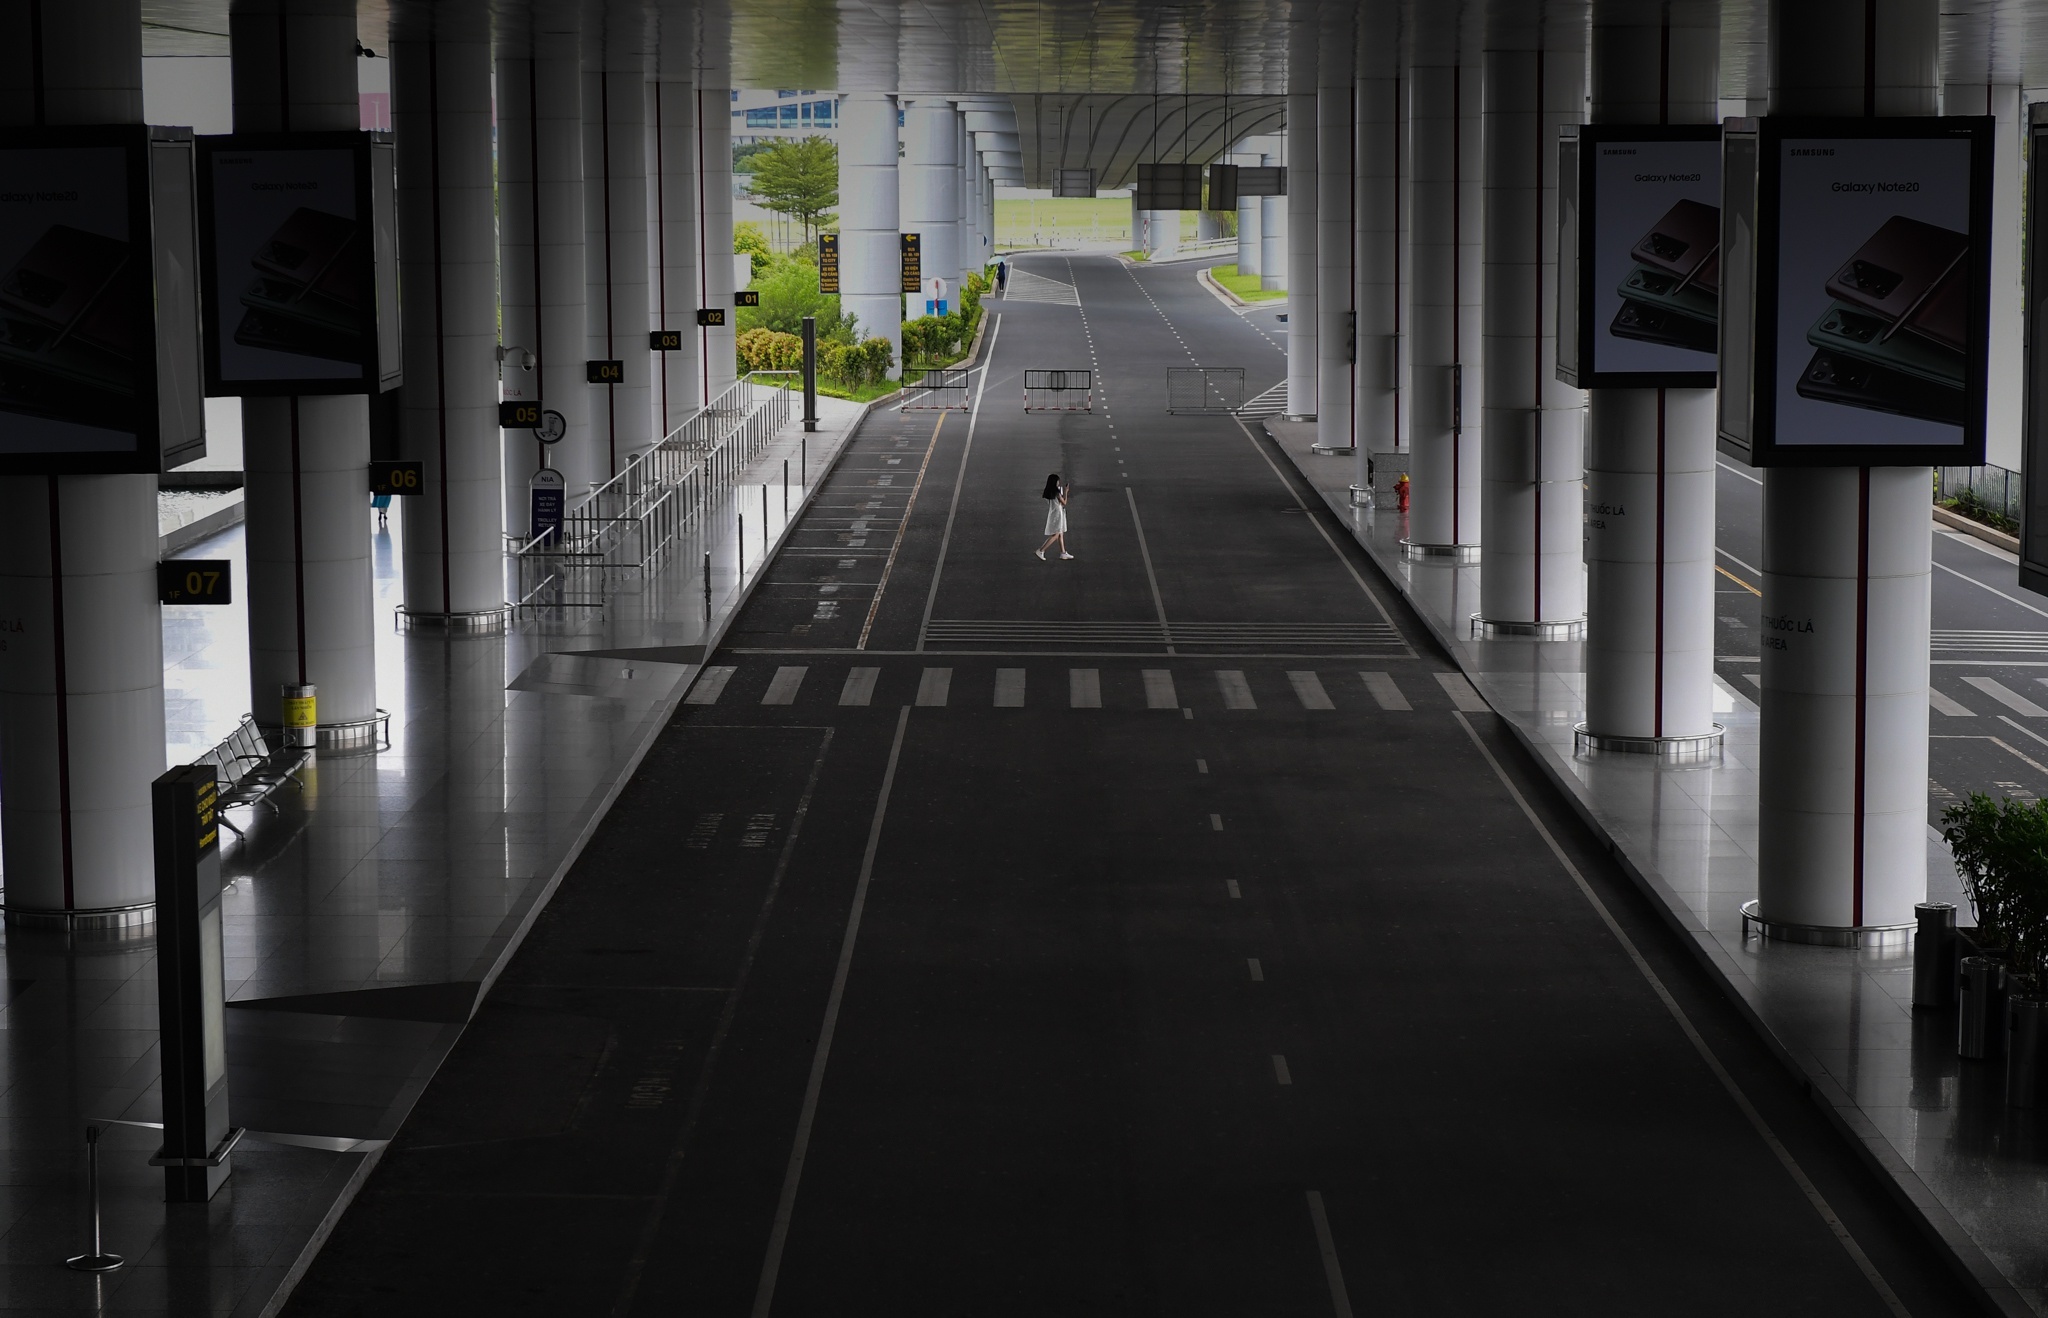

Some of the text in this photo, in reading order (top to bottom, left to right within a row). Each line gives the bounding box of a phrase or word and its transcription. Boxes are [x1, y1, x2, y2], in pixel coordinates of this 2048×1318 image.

[1790, 149, 1835, 157] SAMSUNG
[1634, 174, 1701, 183] Galaxy Note20
[251, 182, 318, 192] Galaxy Note20
[1831, 182, 1920, 195] Galaxy Note20
[36, 191, 78, 201] Note20
[745, 294, 757, 304] 01
[708, 312, 722, 323] 02
[662, 335, 678, 347] 03
[600, 365, 619, 378] 04
[515, 407, 537, 423] 05
[391, 469, 417, 488] 06
[1613, 504, 1625, 516] LÁ
[168, 571, 221, 599] 1F 07
[1797, 618, 1814, 633] LÁ
[1765, 636, 1787, 651] AREA
